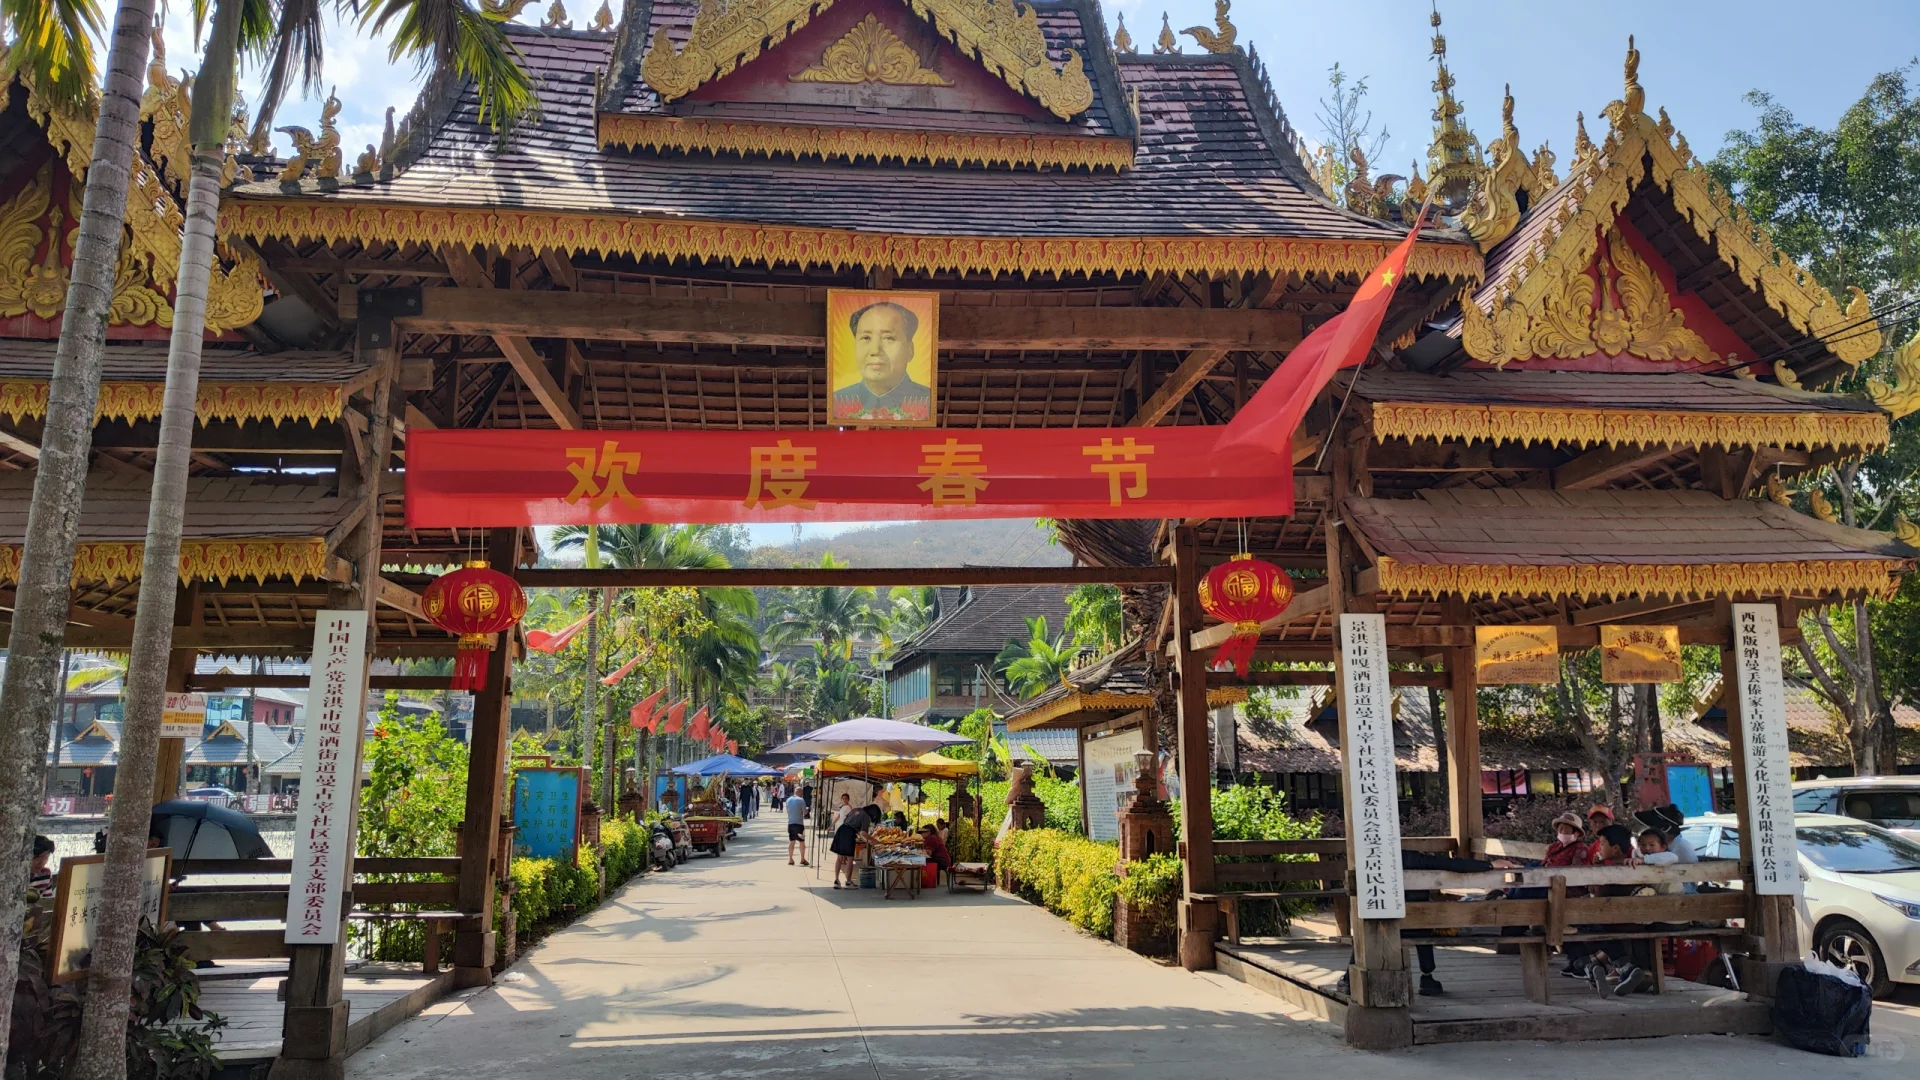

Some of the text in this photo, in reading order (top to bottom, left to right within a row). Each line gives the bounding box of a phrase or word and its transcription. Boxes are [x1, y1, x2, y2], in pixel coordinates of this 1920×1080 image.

[564, 437, 1155, 511] 欢度春节
[1228, 574, 1255, 598] 福
[464, 587, 493, 612] 福
[521, 819, 569, 829] 爱护环境
